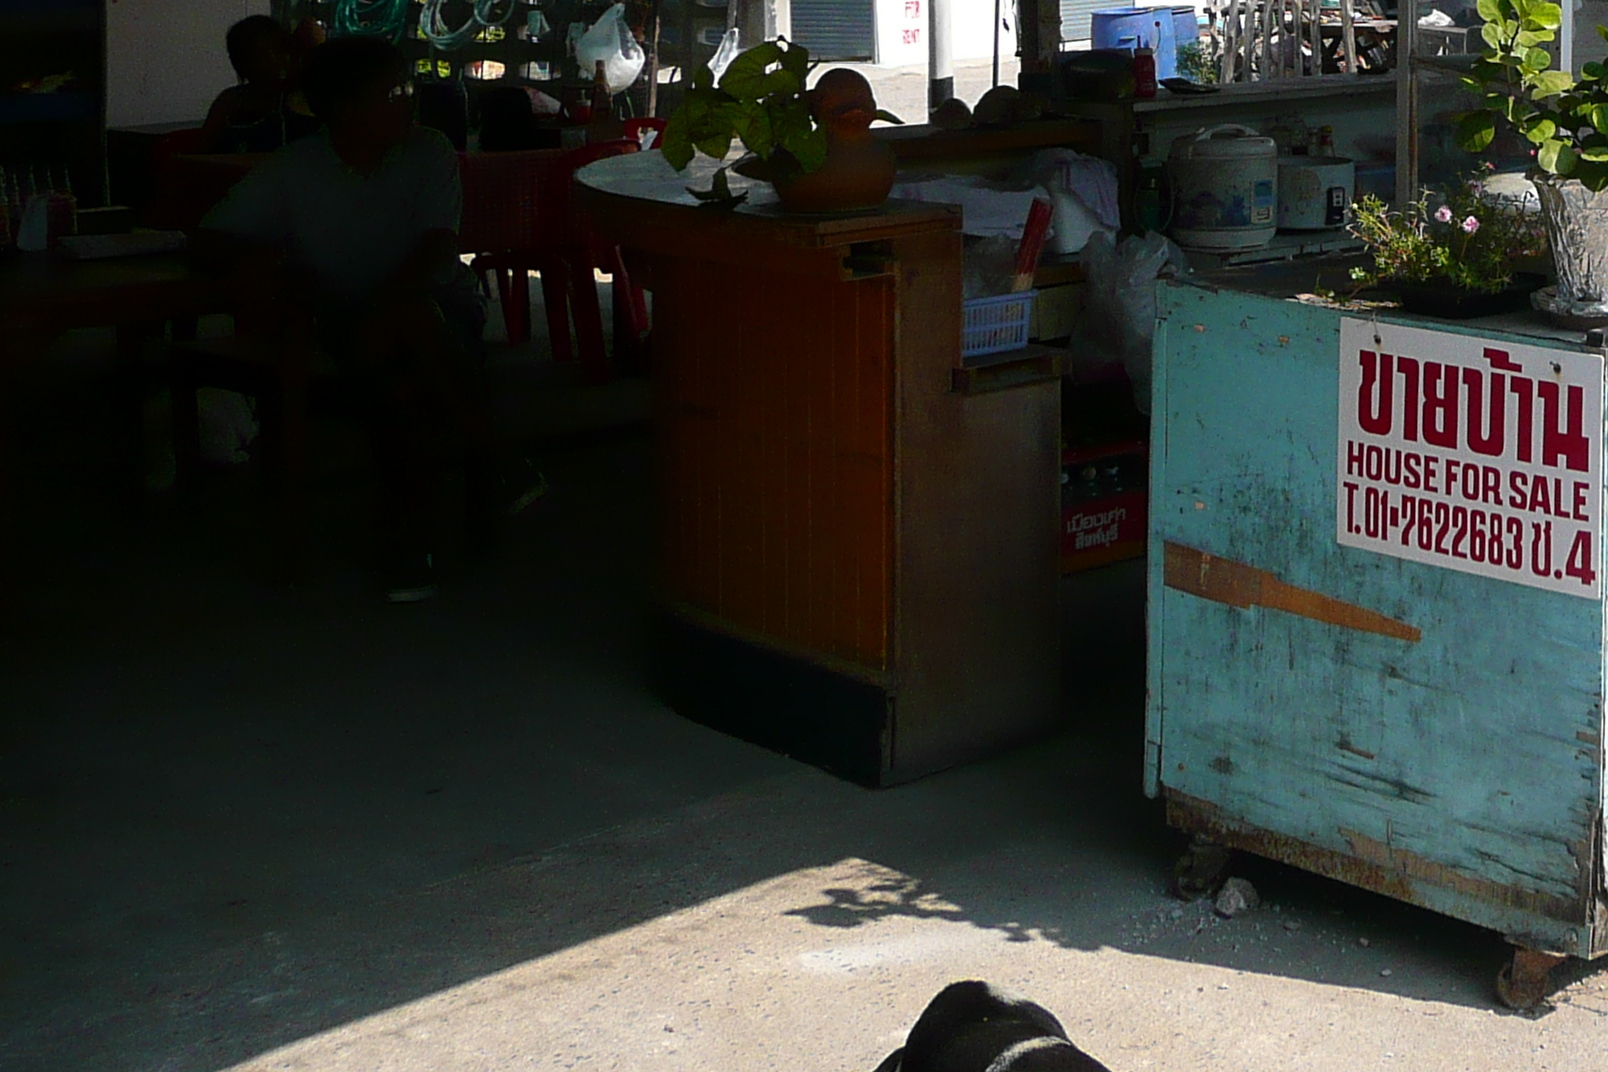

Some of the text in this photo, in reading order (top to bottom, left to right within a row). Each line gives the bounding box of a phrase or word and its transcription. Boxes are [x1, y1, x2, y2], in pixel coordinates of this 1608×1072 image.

[1358, 347, 1590, 472] ขายบ้าน
[1347, 440, 1590, 523] HOUSE FOR SALE
